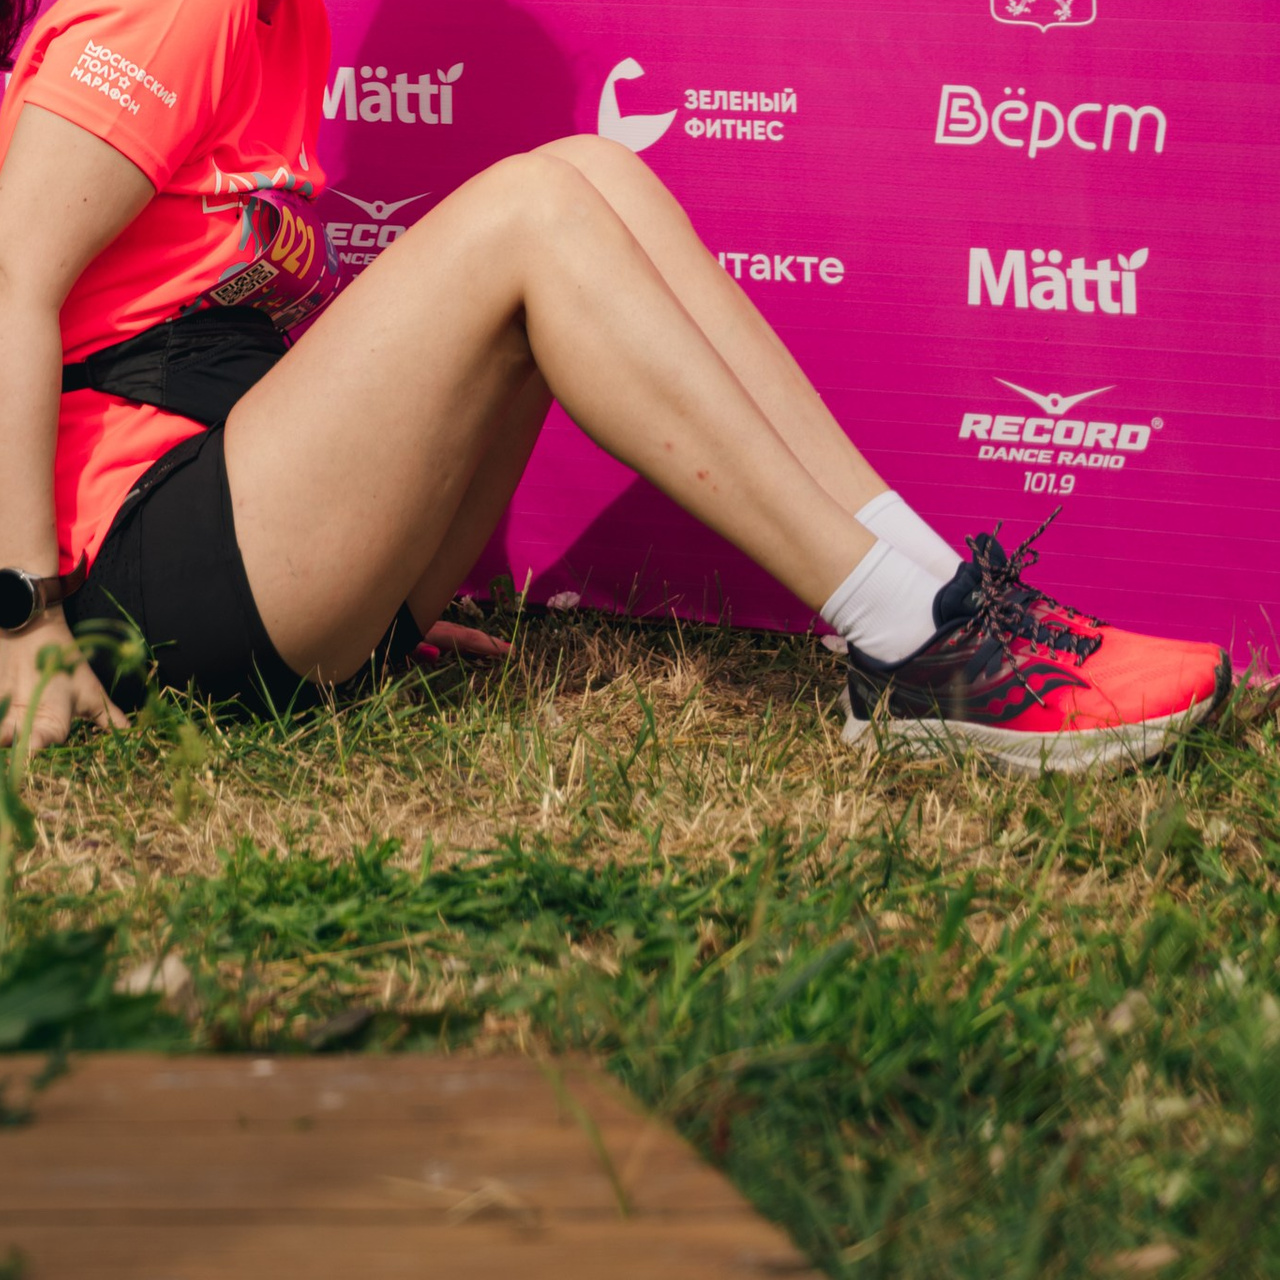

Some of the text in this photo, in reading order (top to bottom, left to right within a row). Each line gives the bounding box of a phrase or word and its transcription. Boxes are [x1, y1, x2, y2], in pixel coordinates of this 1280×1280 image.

[77, 54, 120, 81] ПОЛУ
[84, 39, 177, 108] МОСКОВСКИЙ
[70, 66, 140, 115] МАРАФОН
[323, 63, 463, 124] Mätti
[684, 88, 797, 113] ЗЕЛЕНЫЙ
[684, 117, 784, 141] ФИТНЕС
[968, 247, 1149, 315] Mätti
[978, 446, 1125, 469] DANCE RADIO
[1024, 472, 1075, 495] 101.9
